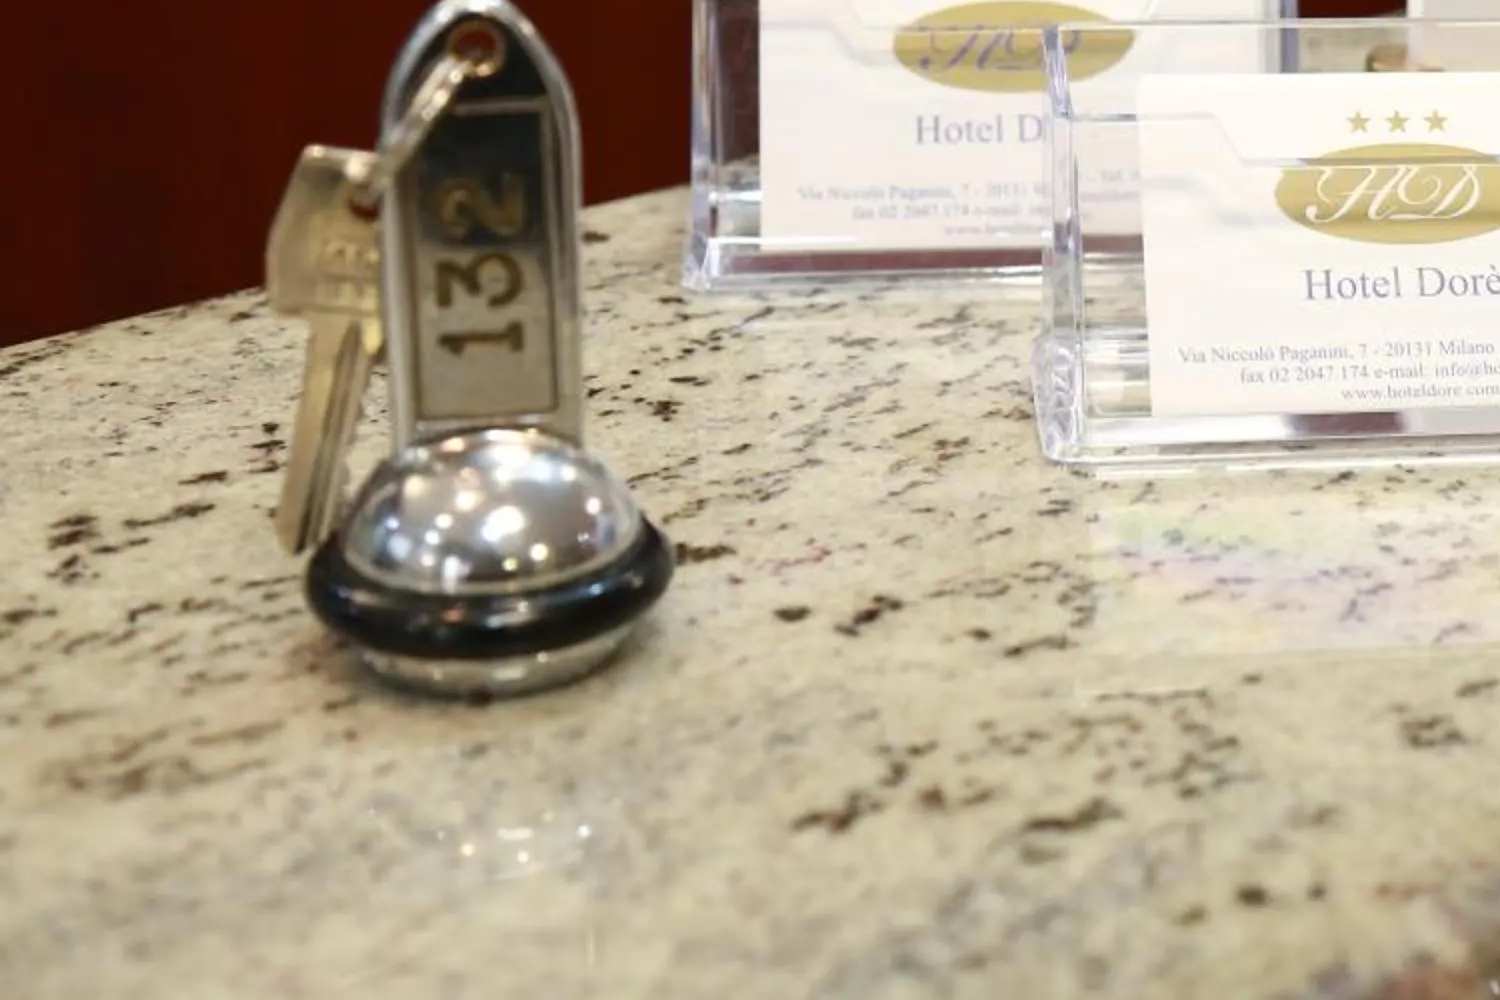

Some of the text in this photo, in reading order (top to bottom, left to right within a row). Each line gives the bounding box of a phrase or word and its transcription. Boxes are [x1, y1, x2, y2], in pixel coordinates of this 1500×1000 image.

[916, 112, 1003, 145] Hotel
[434, 174, 526, 358] 132
[1303, 266, 1403, 300] Hotel
[1178, 345, 1205, 363] Via
[1358, 342, 1368, 356] 7
[1386, 341, 1432, 358] 20131
[1439, 337, 1496, 356] Milano
[1240, 366, 1265, 384] fax
[1269, 366, 1290, 382] 02
[1340, 381, 1500, 400] www.hoteldore.com
